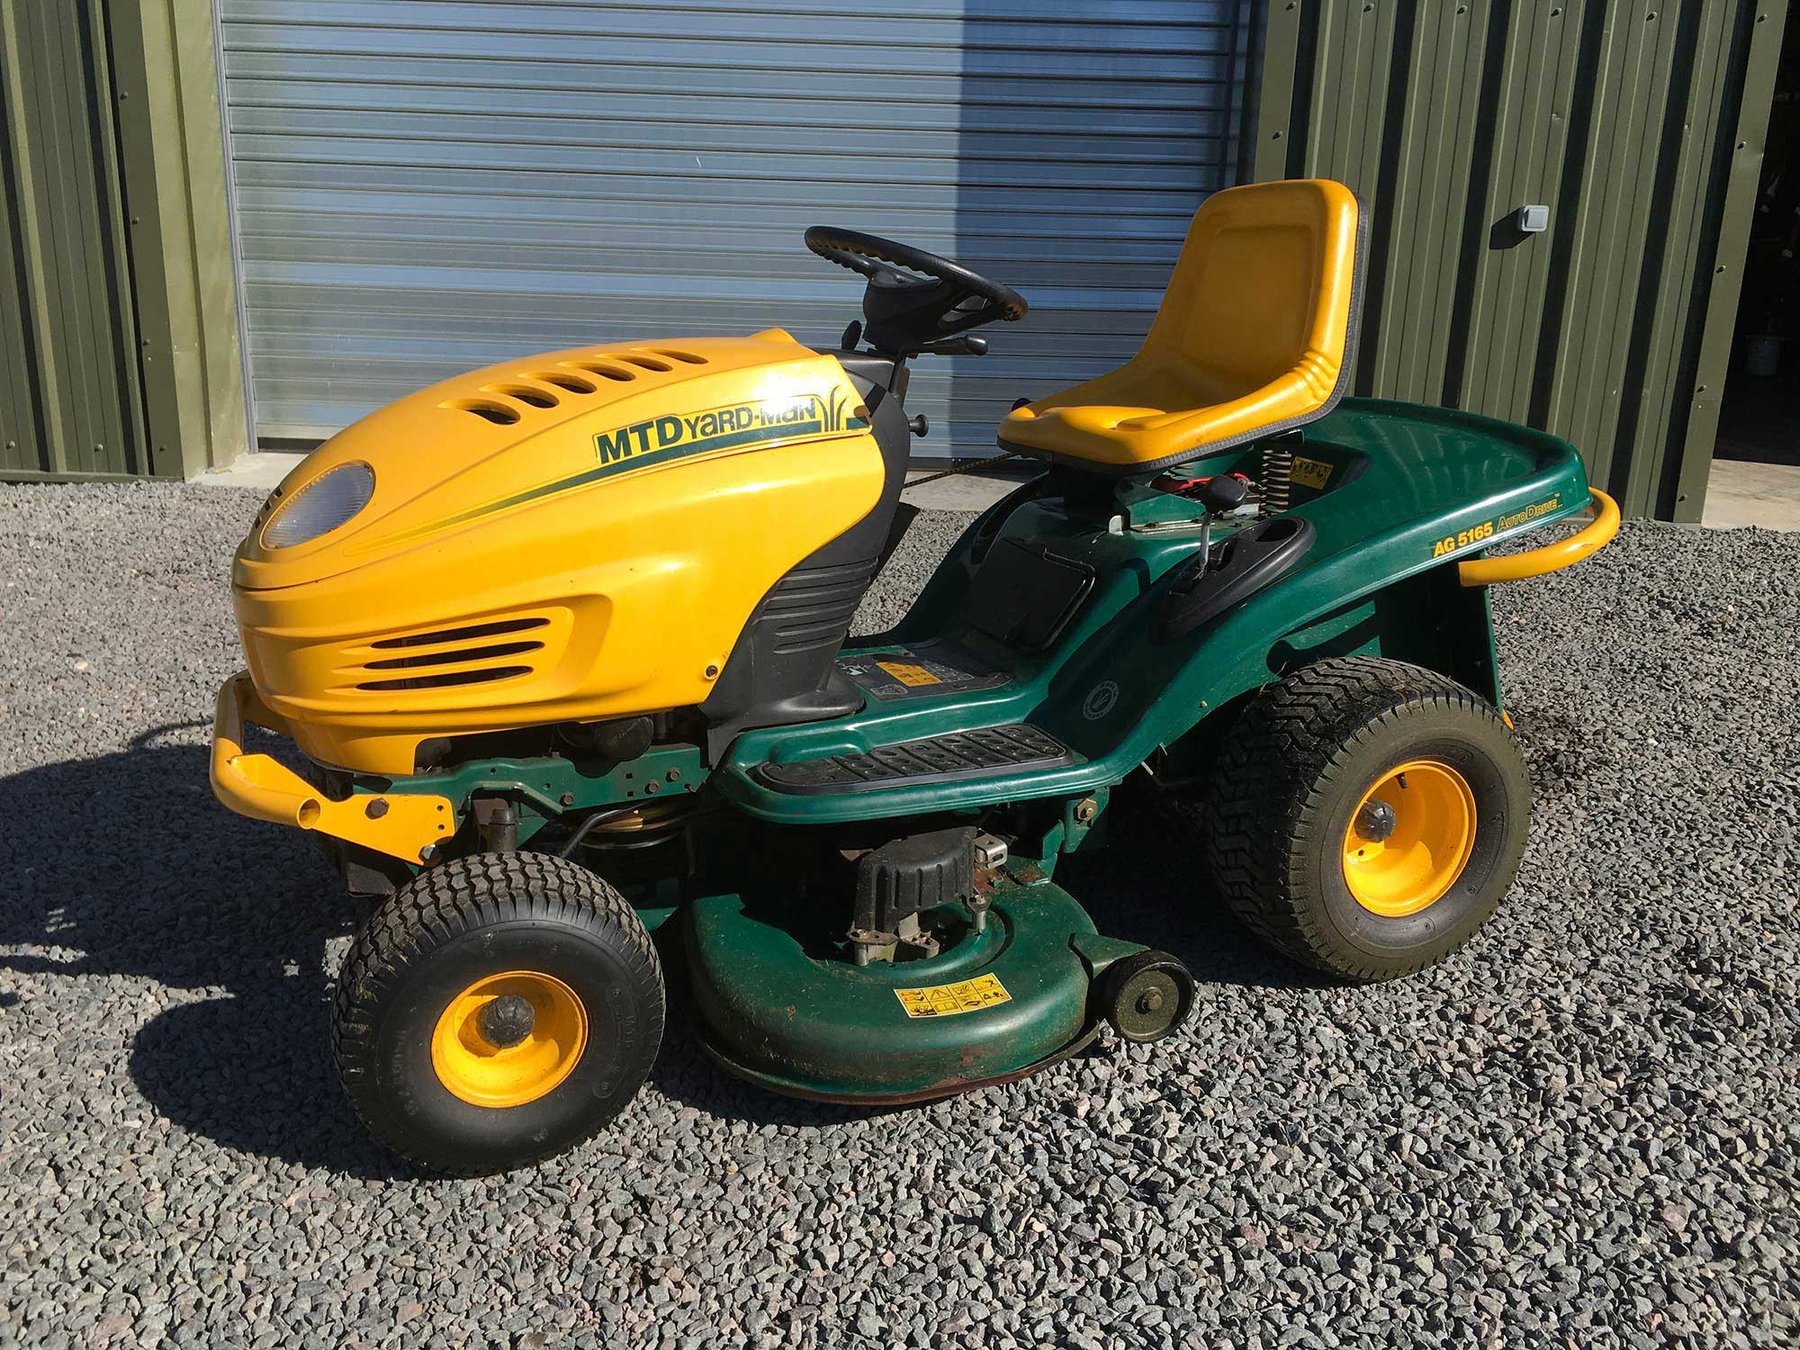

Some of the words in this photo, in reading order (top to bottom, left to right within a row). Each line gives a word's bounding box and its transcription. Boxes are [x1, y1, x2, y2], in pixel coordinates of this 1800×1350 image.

[596, 415, 683, 464] MTD
[1433, 536, 1455, 557] AG
[1457, 522, 1493, 547] 5165
